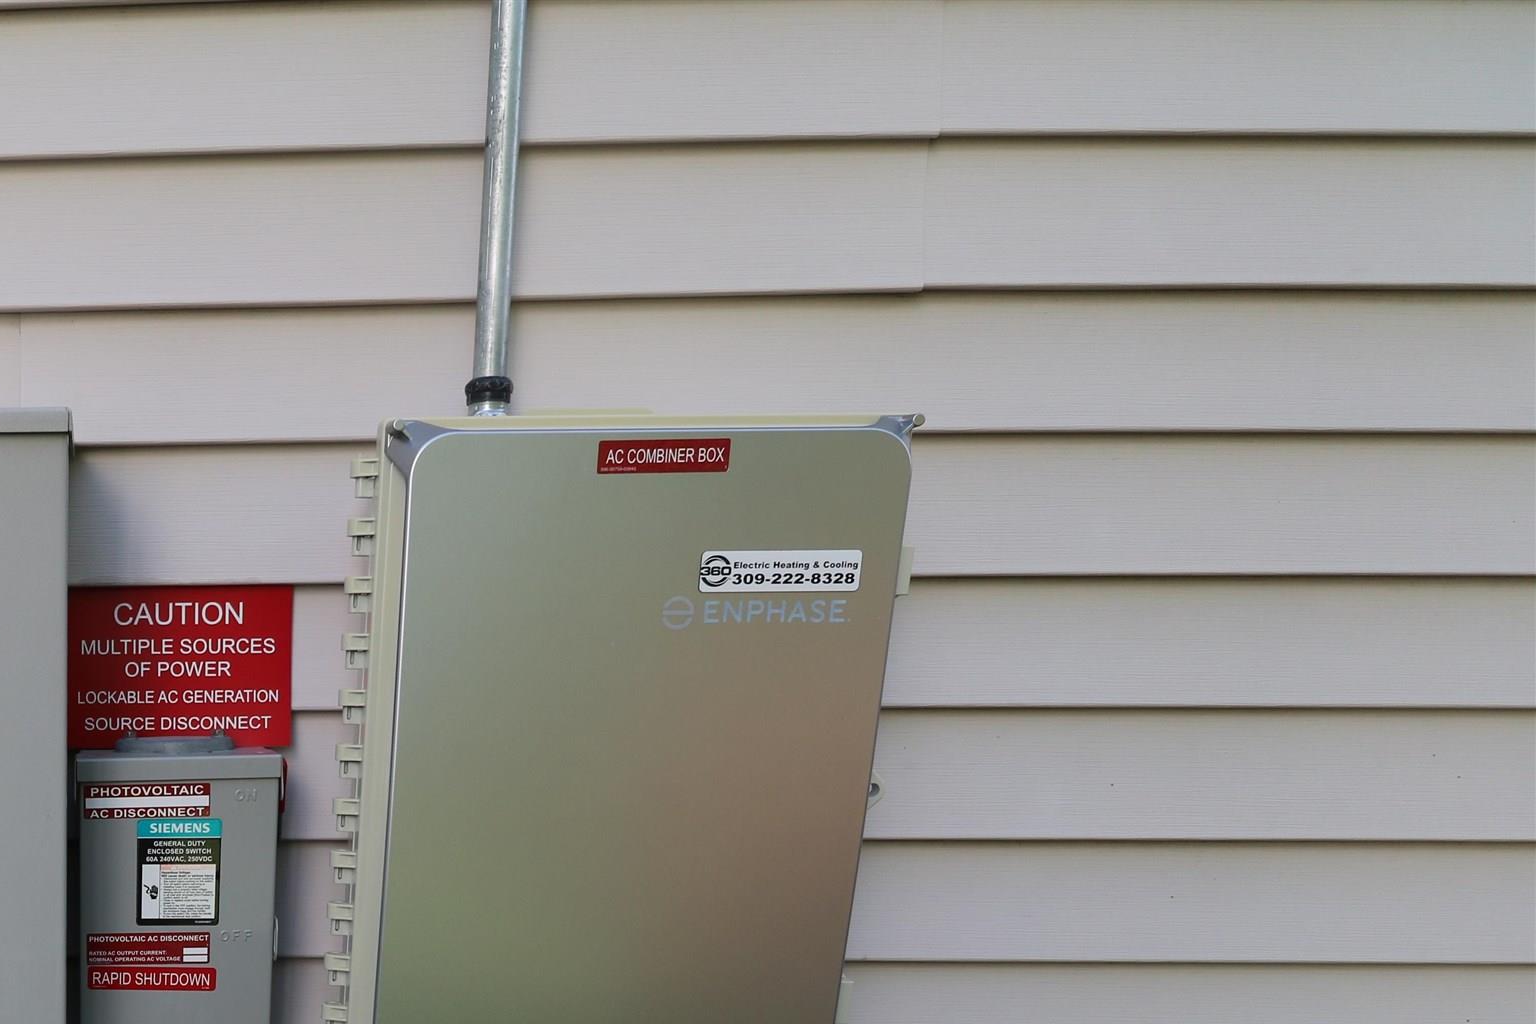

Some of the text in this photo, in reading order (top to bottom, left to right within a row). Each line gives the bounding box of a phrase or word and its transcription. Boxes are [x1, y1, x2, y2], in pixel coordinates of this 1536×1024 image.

[606, 447, 725, 464] AC COMBINER BOX
[699, 566, 732, 576] 360
[733, 561, 859, 571] Electric Heating & Cooling
[732, 572, 855, 585] 309-222-8328
[113, 601, 244, 626] CAUTION
[703, 599, 848, 624] ENPHASE
[80, 638, 276, 655] MULTIPLE SOURCES
[124, 661, 231, 677] OF POWER
[77, 689, 279, 704] LOCKABLE AC GENERATION
[84, 715, 272, 731] SOURCE DISCONNECT
[90, 785, 204, 797] PHOTOVOLTAIC
[90, 807, 205, 818] AC DISCONNECT
[149, 822, 210, 834] SIEMENS
[88, 935, 146, 943] PHOTOVOLTAIC
[160, 934, 209, 942] DISCONNECT
[92, 971, 210, 986] RAPID SHUTDOWN
